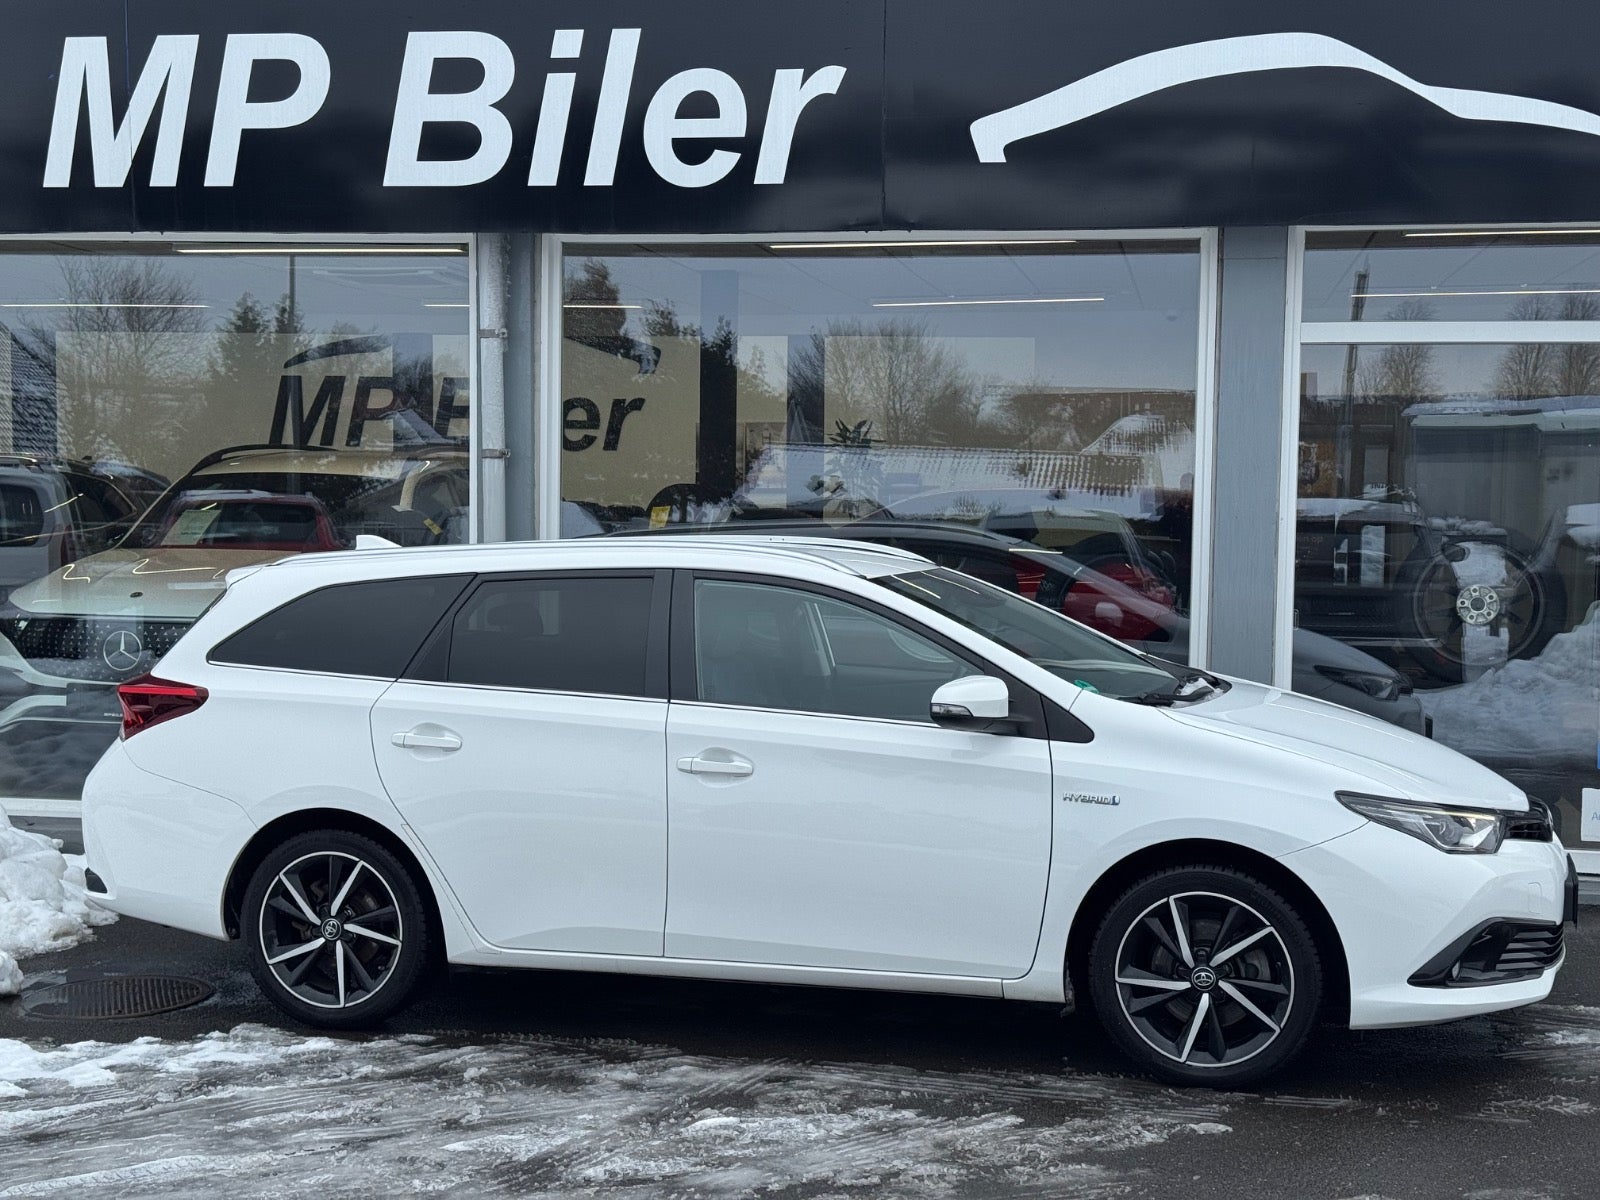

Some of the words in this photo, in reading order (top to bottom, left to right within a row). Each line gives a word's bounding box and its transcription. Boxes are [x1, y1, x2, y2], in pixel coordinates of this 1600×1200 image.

[43, 33, 330, 187] MP
[383, 28, 847, 187] Biler
[268, 375, 400, 448] MP
[433, 376, 646, 452] Ber
[1063, 793, 1112, 805] HYBRID
